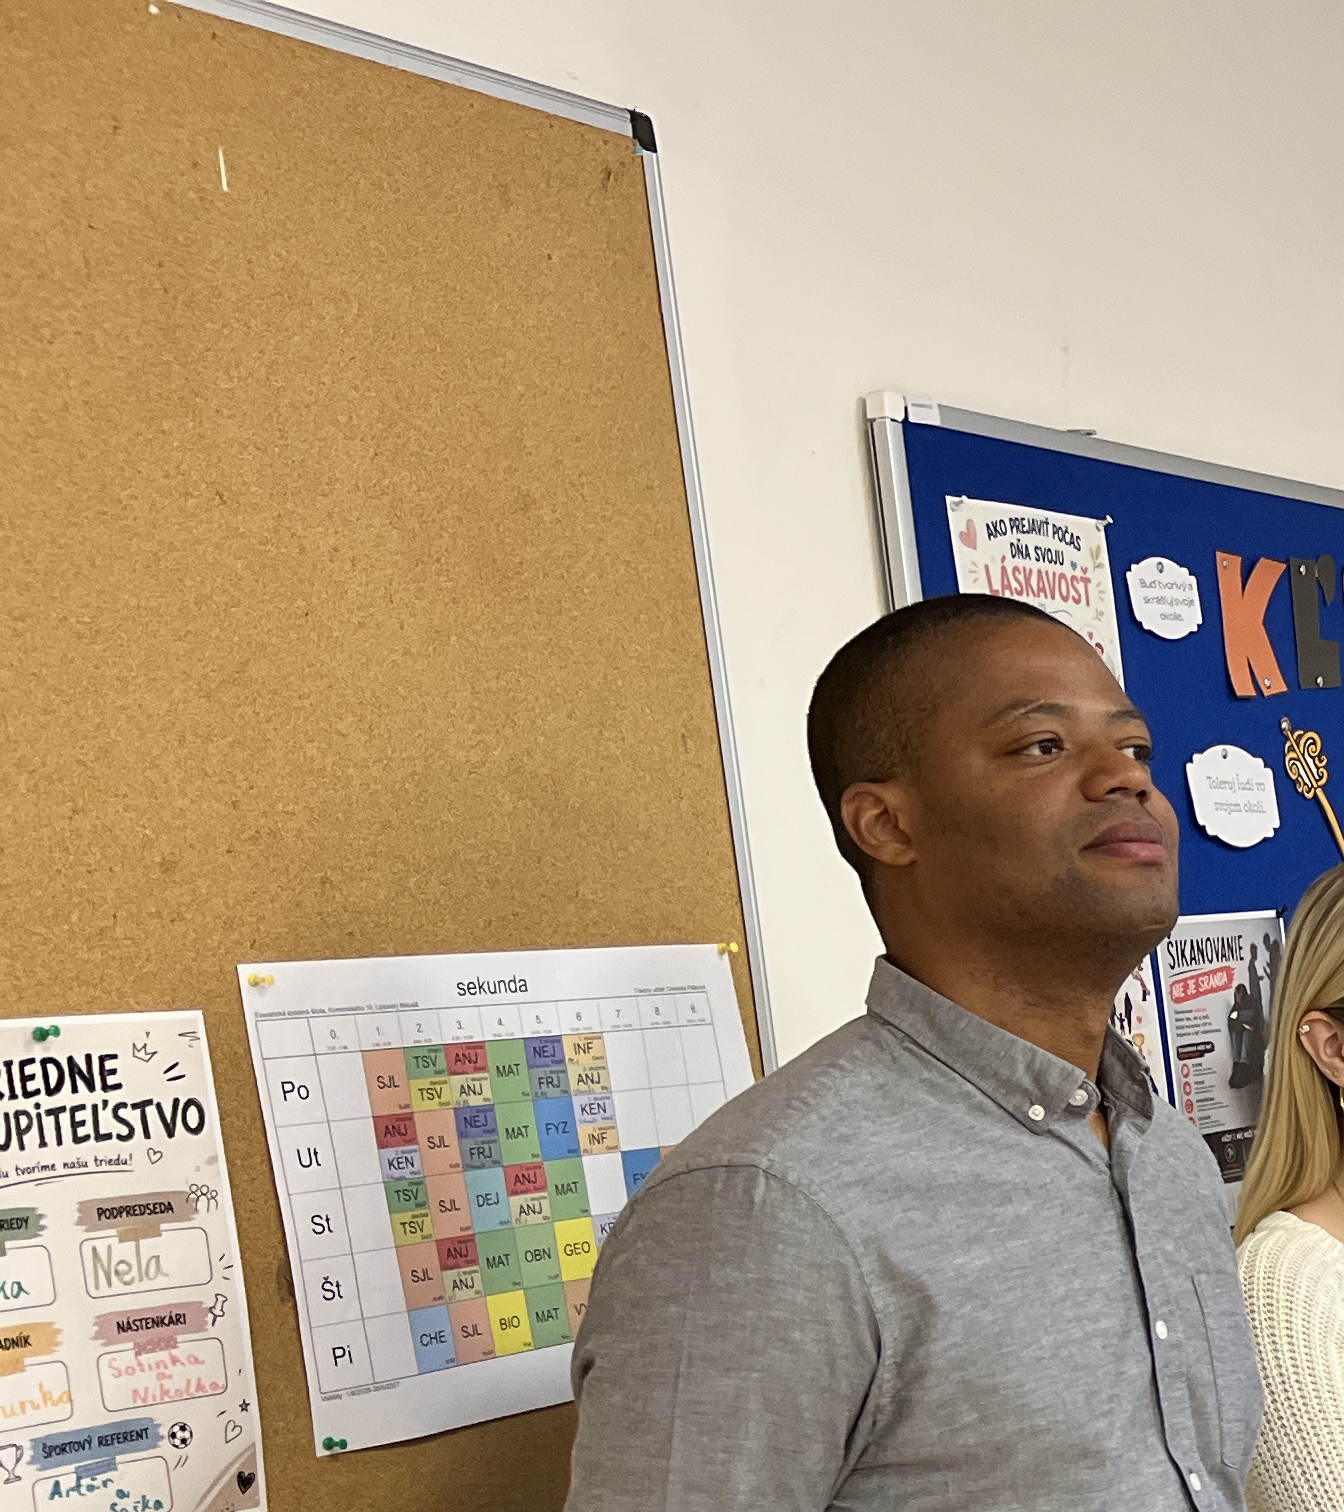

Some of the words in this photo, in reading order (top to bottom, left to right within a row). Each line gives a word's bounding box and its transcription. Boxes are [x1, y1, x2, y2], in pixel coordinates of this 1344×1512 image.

[985, 519, 1007, 541] AKO
[1008, 517, 1050, 537] PREJAVIŤ
[1052, 524, 1081, 551] POČAS
[1010, 539, 1031, 561] DŇA
[1034, 545, 1064, 566] SVOJU
[984, 554, 1092, 607] LÁSKAVOSŤ
[457, 975, 528, 996] sekunda
[1187, 979, 1197, 995] JE
[1199, 971, 1228, 992] SRANDA
[532, 1045, 556, 1058] NEJ
[573, 1042, 594, 1055] INF
[412, 1055, 438, 1069] TSV
[454, 1052, 479, 1066] ANJ
[0, 1053, 123, 1101] IEDNE
[496, 1063, 521, 1077] MAT
[377, 1075, 400, 1089] SJL
[538, 1075, 561, 1090] FRJ
[577, 1072, 600, 1086] ANJ
[281, 1081, 310, 1101] Po
[418, 1087, 443, 1101] TSV
[459, 1083, 484, 1097] ANJ
[580, 1102, 607, 1116] KEN
[464, 1115, 488, 1129] NEJ
[545, 1121, 569, 1136] FYZ
[384, 1123, 408, 1138] ANJ
[505, 1125, 529, 1140] MAT
[427, 1135, 450, 1150] SJL
[588, 1132, 608, 1145] INF
[296, 1147, 321, 1169] Ut
[469, 1146, 493, 1160] FRJ
[15, 1161, 57, 1177] tvoríme
[63, 1155, 89, 1169] našu
[94, 1153, 133, 1168] triedu!
[387, 1156, 415, 1171] KEN
[513, 1172, 538, 1187] ANJ
[394, 1187, 419, 1203] TSV
[554, 1182, 579, 1196] MAT
[438, 1199, 461, 1213] SJL
[476, 1192, 500, 1208] DEJ
[96, 1201, 174, 1221] PODPREDSEDA
[518, 1202, 542, 1217] ANJ
[310, 1214, 333, 1235] St
[400, 1220, 425, 1236] TSV
[446, 1245, 469, 1260] ANJ
[524, 1247, 552, 1263] OBN
[564, 1241, 591, 1257] GEO
[91, 1240, 169, 1290] Nela
[486, 1254, 511, 1270] MAT
[411, 1268, 434, 1283] SJL
[321, 1276, 343, 1301] Št
[452, 1276, 475, 1292] ANJ
[116, 1311, 187, 1334] NÁSTENKÁRI
[499, 1315, 521, 1331] BIO
[535, 1307, 560, 1324] MAT
[420, 1330, 447, 1347] CHE
[461, 1324, 482, 1339] SJL
[332, 1345, 353, 1367] Pi
[155, 1371, 173, 1381] a
[42, 1434, 93, 1459] ŠPORTOVÝ
[97, 1427, 149, 1448] REFERENT
[115, 1488, 130, 1499] a
